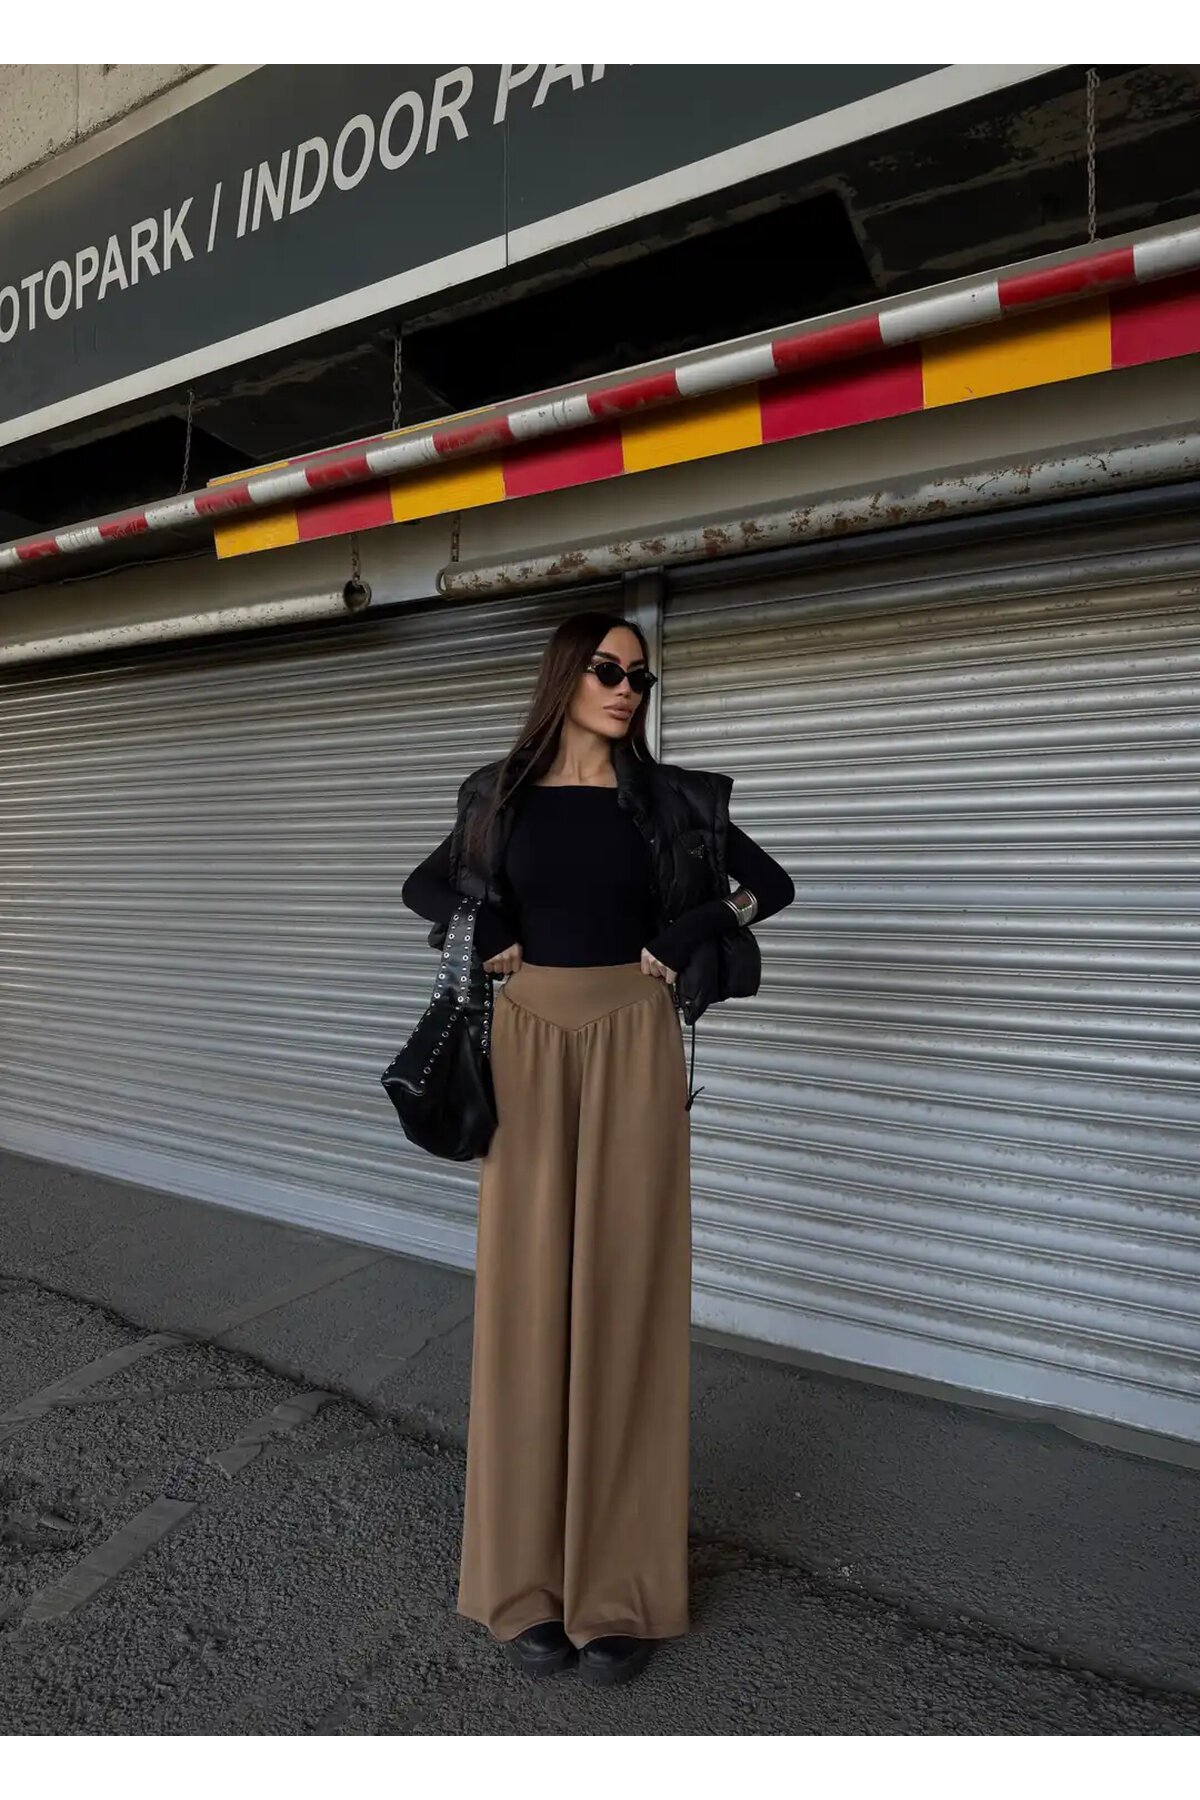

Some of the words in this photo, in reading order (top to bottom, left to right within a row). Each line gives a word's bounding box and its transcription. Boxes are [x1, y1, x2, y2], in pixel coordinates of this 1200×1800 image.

[0, 197, 194, 342] OTOPARK
[207, 182, 222, 252] /
[237, 66, 473, 238] INDOOR
